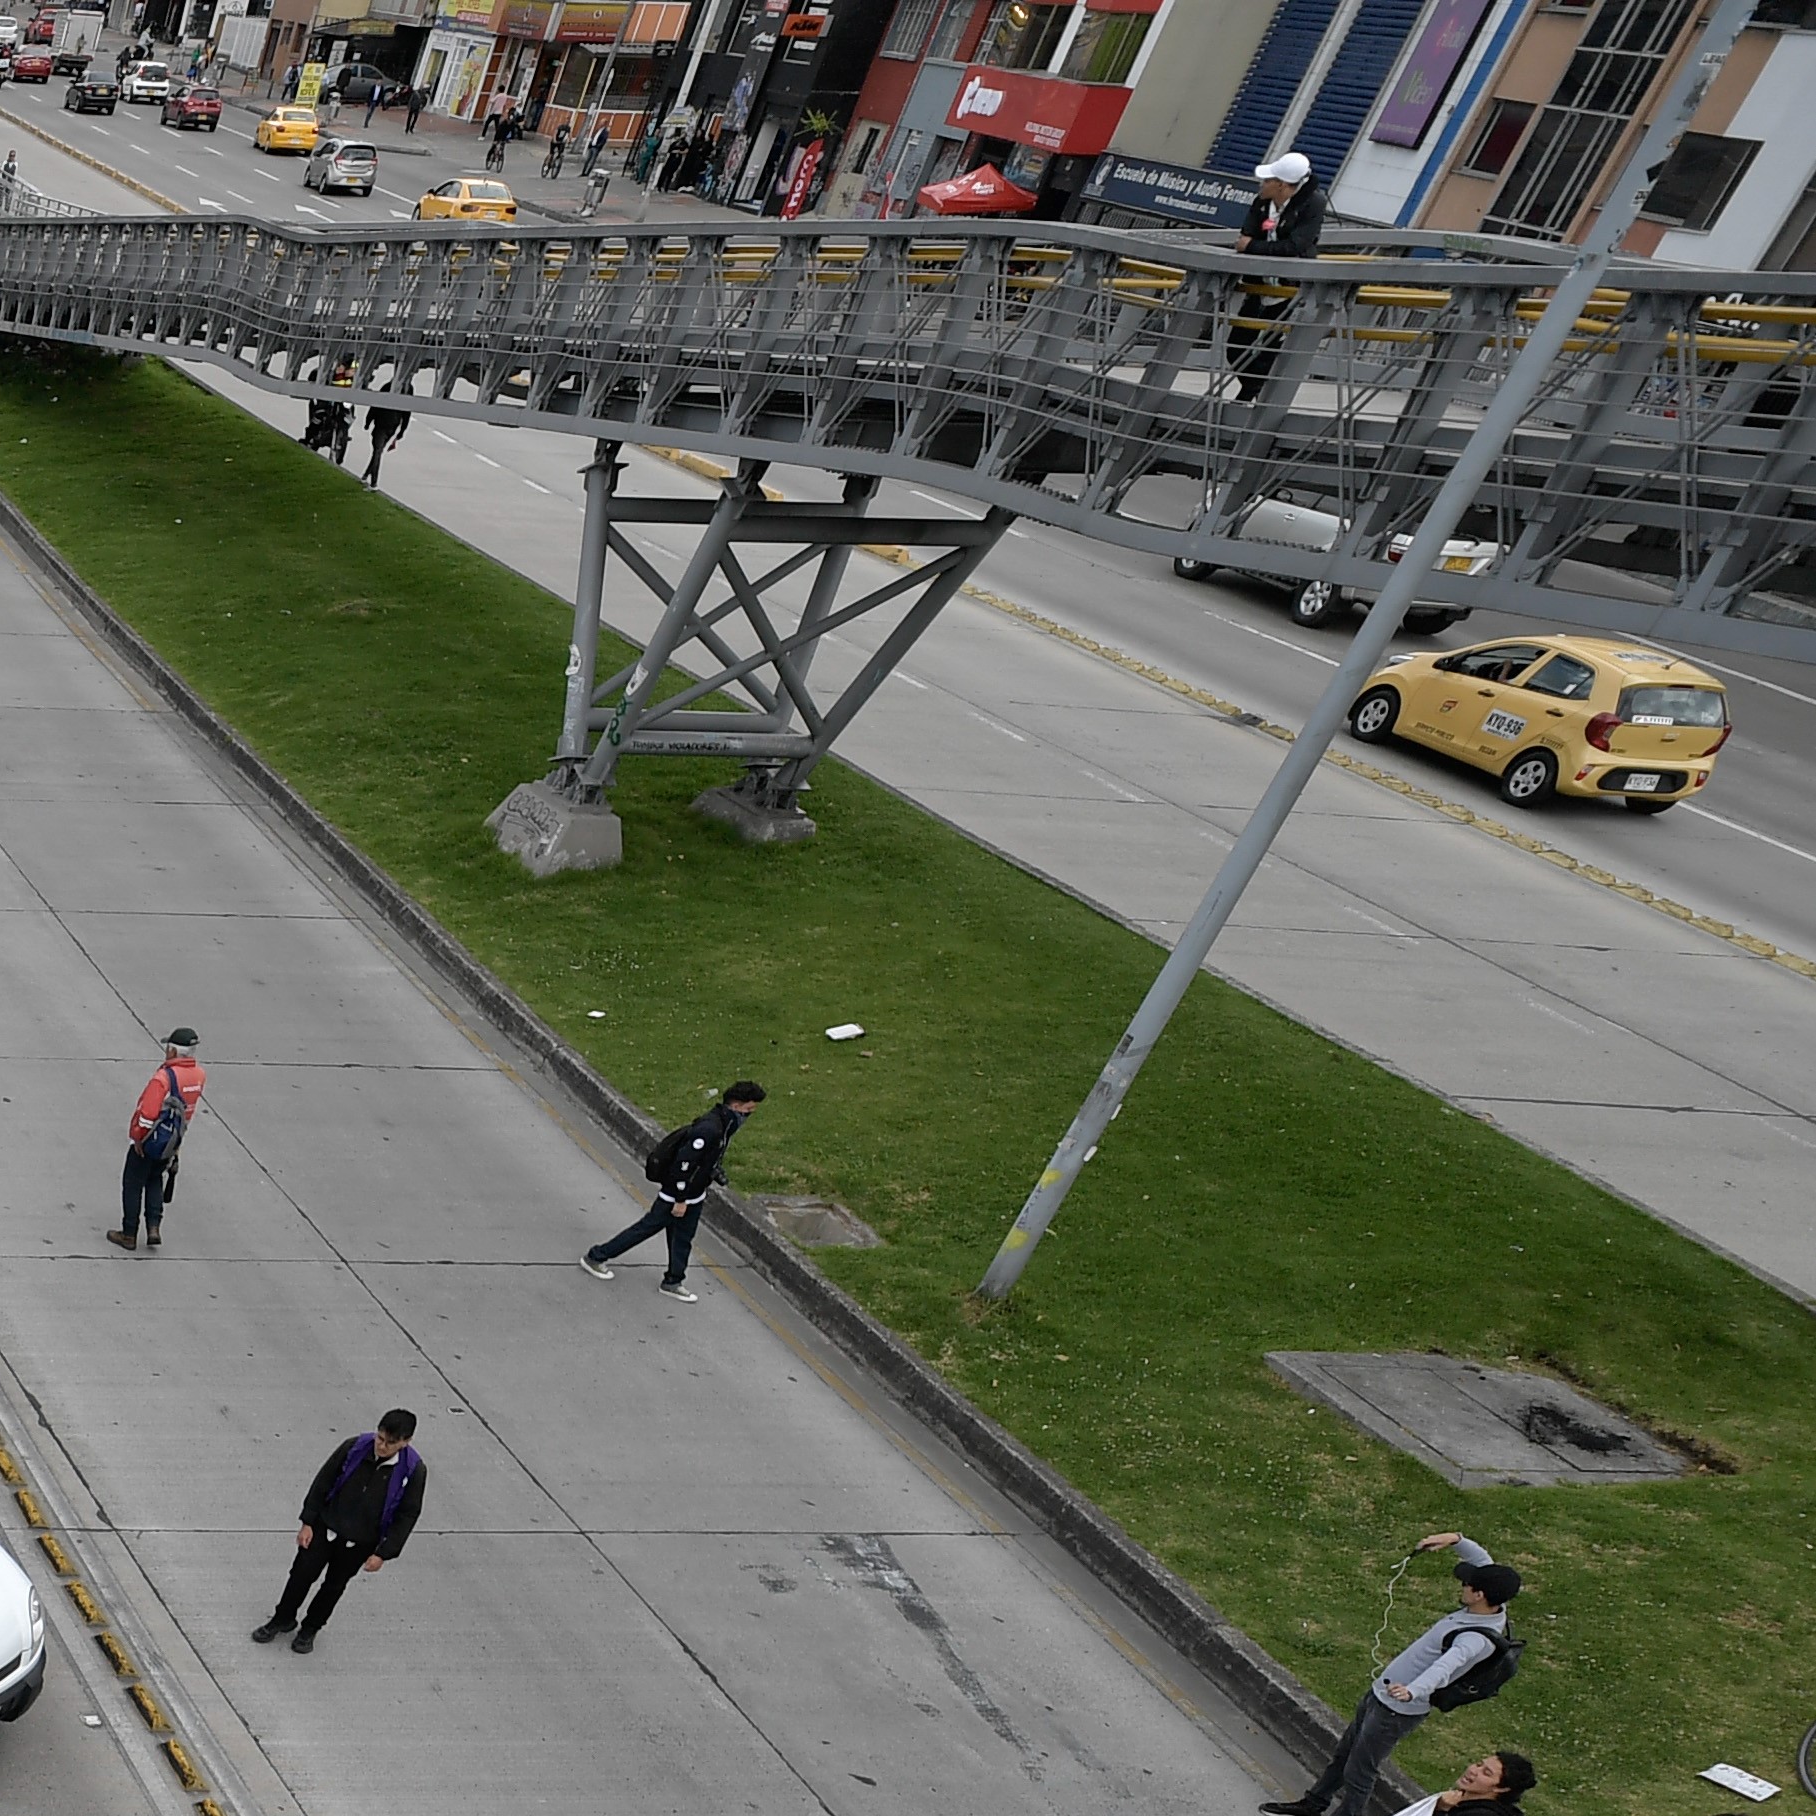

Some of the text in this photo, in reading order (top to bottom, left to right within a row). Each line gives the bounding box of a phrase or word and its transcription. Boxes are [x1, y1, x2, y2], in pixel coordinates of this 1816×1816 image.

[790, 18, 822, 33] KTM
[1113, 163, 1146, 183] Escuela
[1146, 170, 1158, 185] de
[1157, 171, 1188, 191] Música
[1195, 180, 1222, 198] Audio
